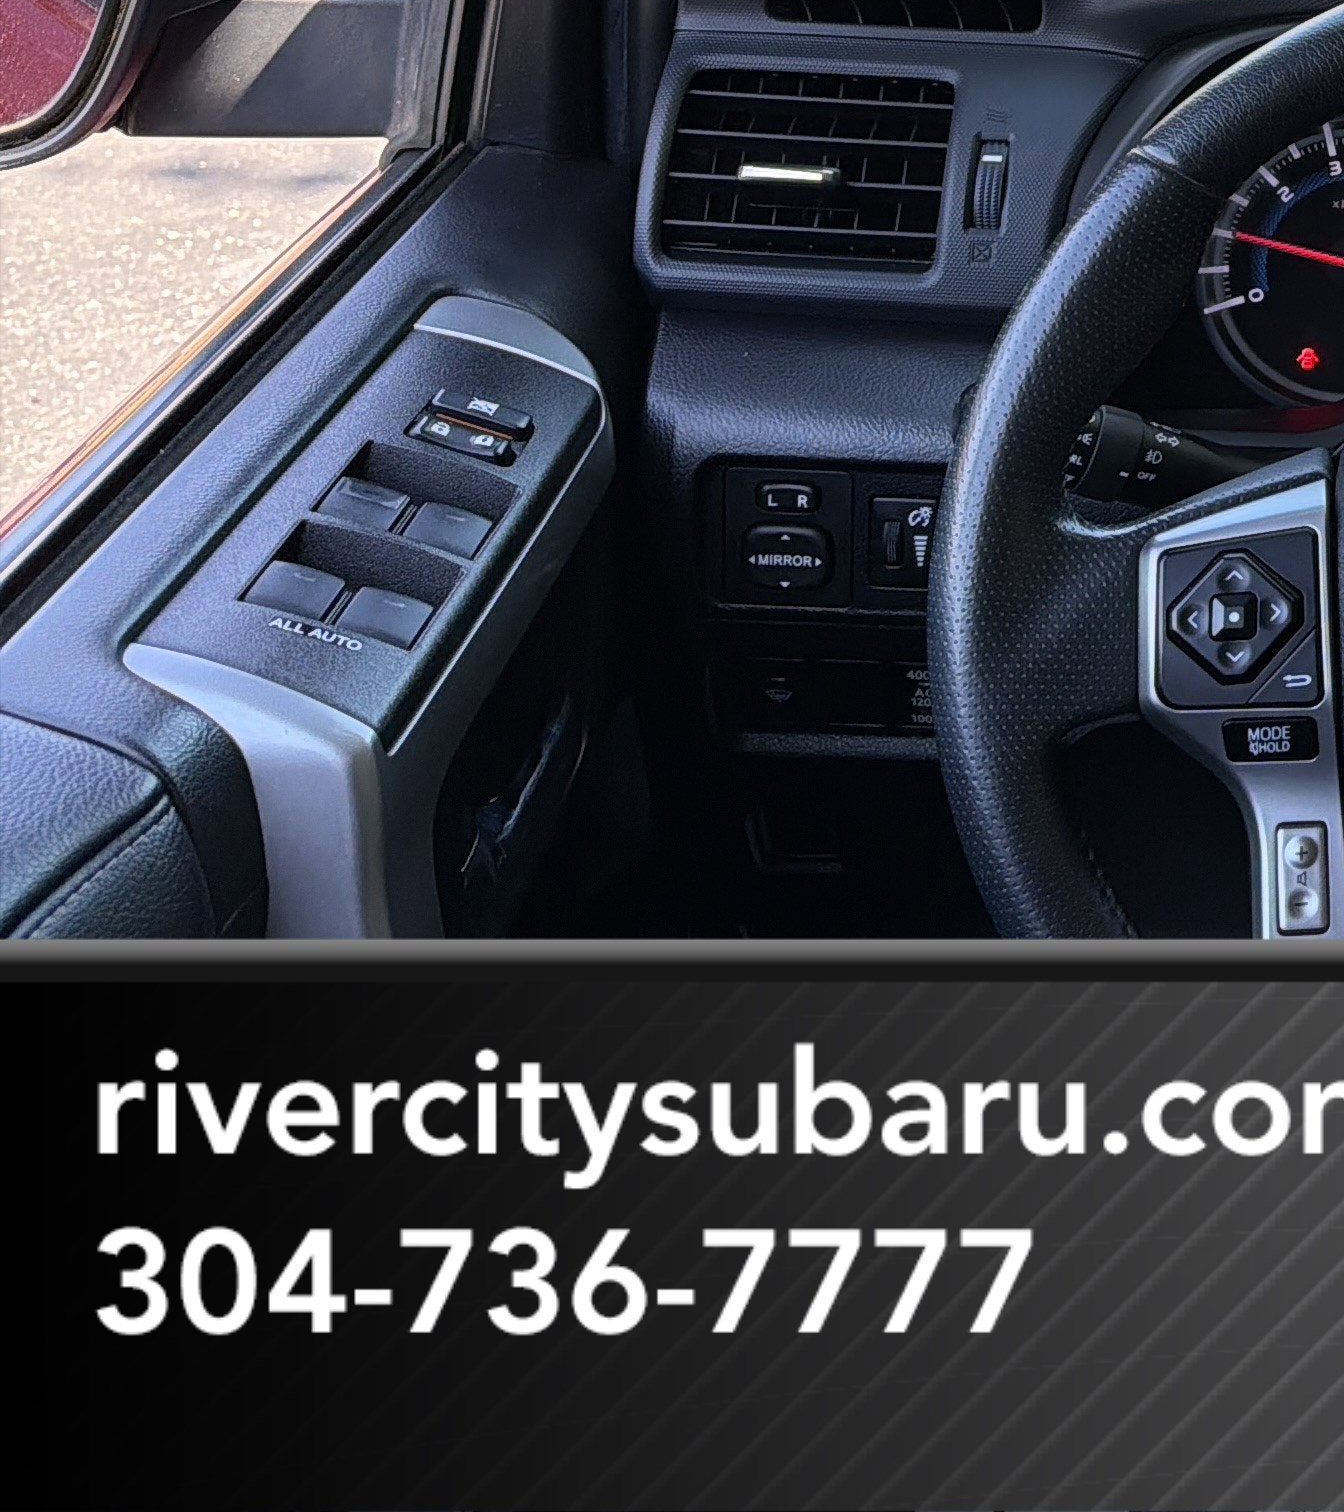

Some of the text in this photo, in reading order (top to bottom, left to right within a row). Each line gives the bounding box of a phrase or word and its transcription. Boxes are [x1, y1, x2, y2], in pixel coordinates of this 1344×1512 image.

[1328, 160, 1343, 177] 3
[1276, 185, 1295, 203] 2
[1247, 287, 1265, 303] 0
[767, 494, 809, 509] L R
[757, 553, 812, 568] MIRROR
[267, 615, 364, 652] ALL AUTO
[1247, 725, 1291, 741] MODE
[1258, 740, 1290, 753] HOLD
